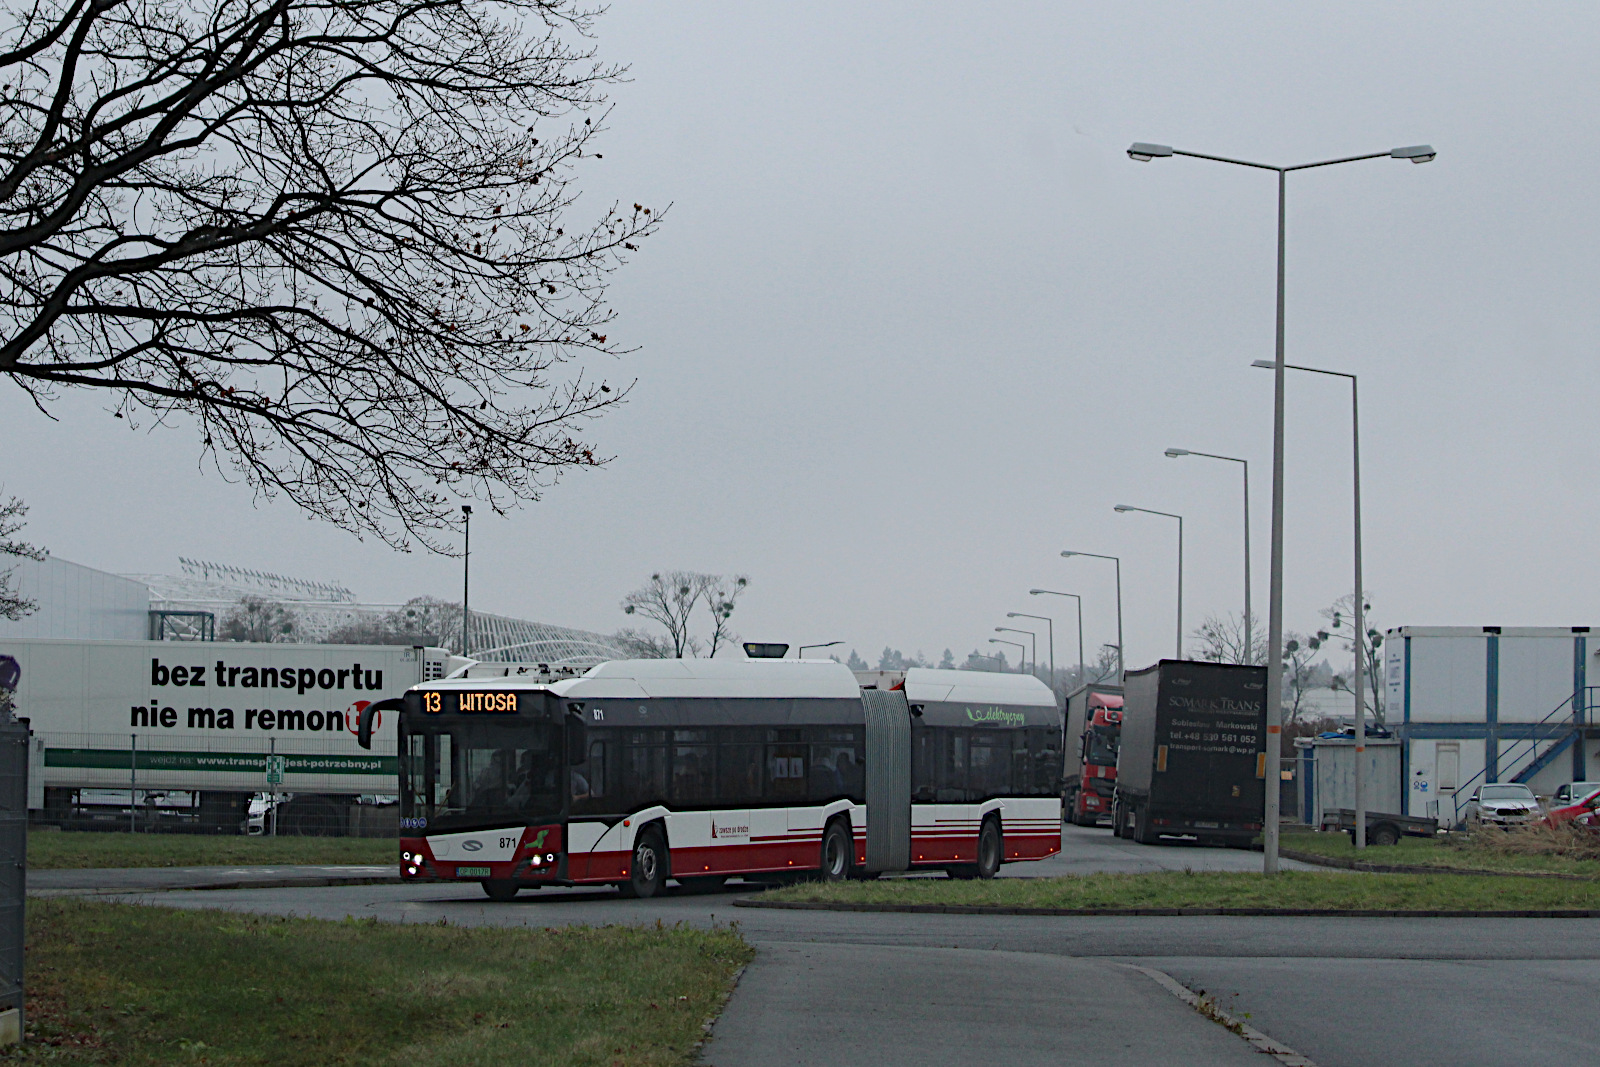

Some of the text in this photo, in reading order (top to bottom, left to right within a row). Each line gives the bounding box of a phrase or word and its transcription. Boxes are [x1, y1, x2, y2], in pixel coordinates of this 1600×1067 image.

[151, 658, 383, 695] bez transportu
[423, 692, 517, 712] 13 WITOSA
[1220, 698, 1261, 712] TRANS
[130, 700, 178, 729] nie
[187, 705, 235, 730] ma
[593, 708, 604, 721] 871
[985, 706, 1025, 727] elektryczny
[1215, 721, 1258, 731] Markowski
[1203, 732, 1219, 741] 530
[1221, 733, 1237, 743] 561
[1240, 735, 1257, 744] 052
[499, 837, 516, 849] 871
